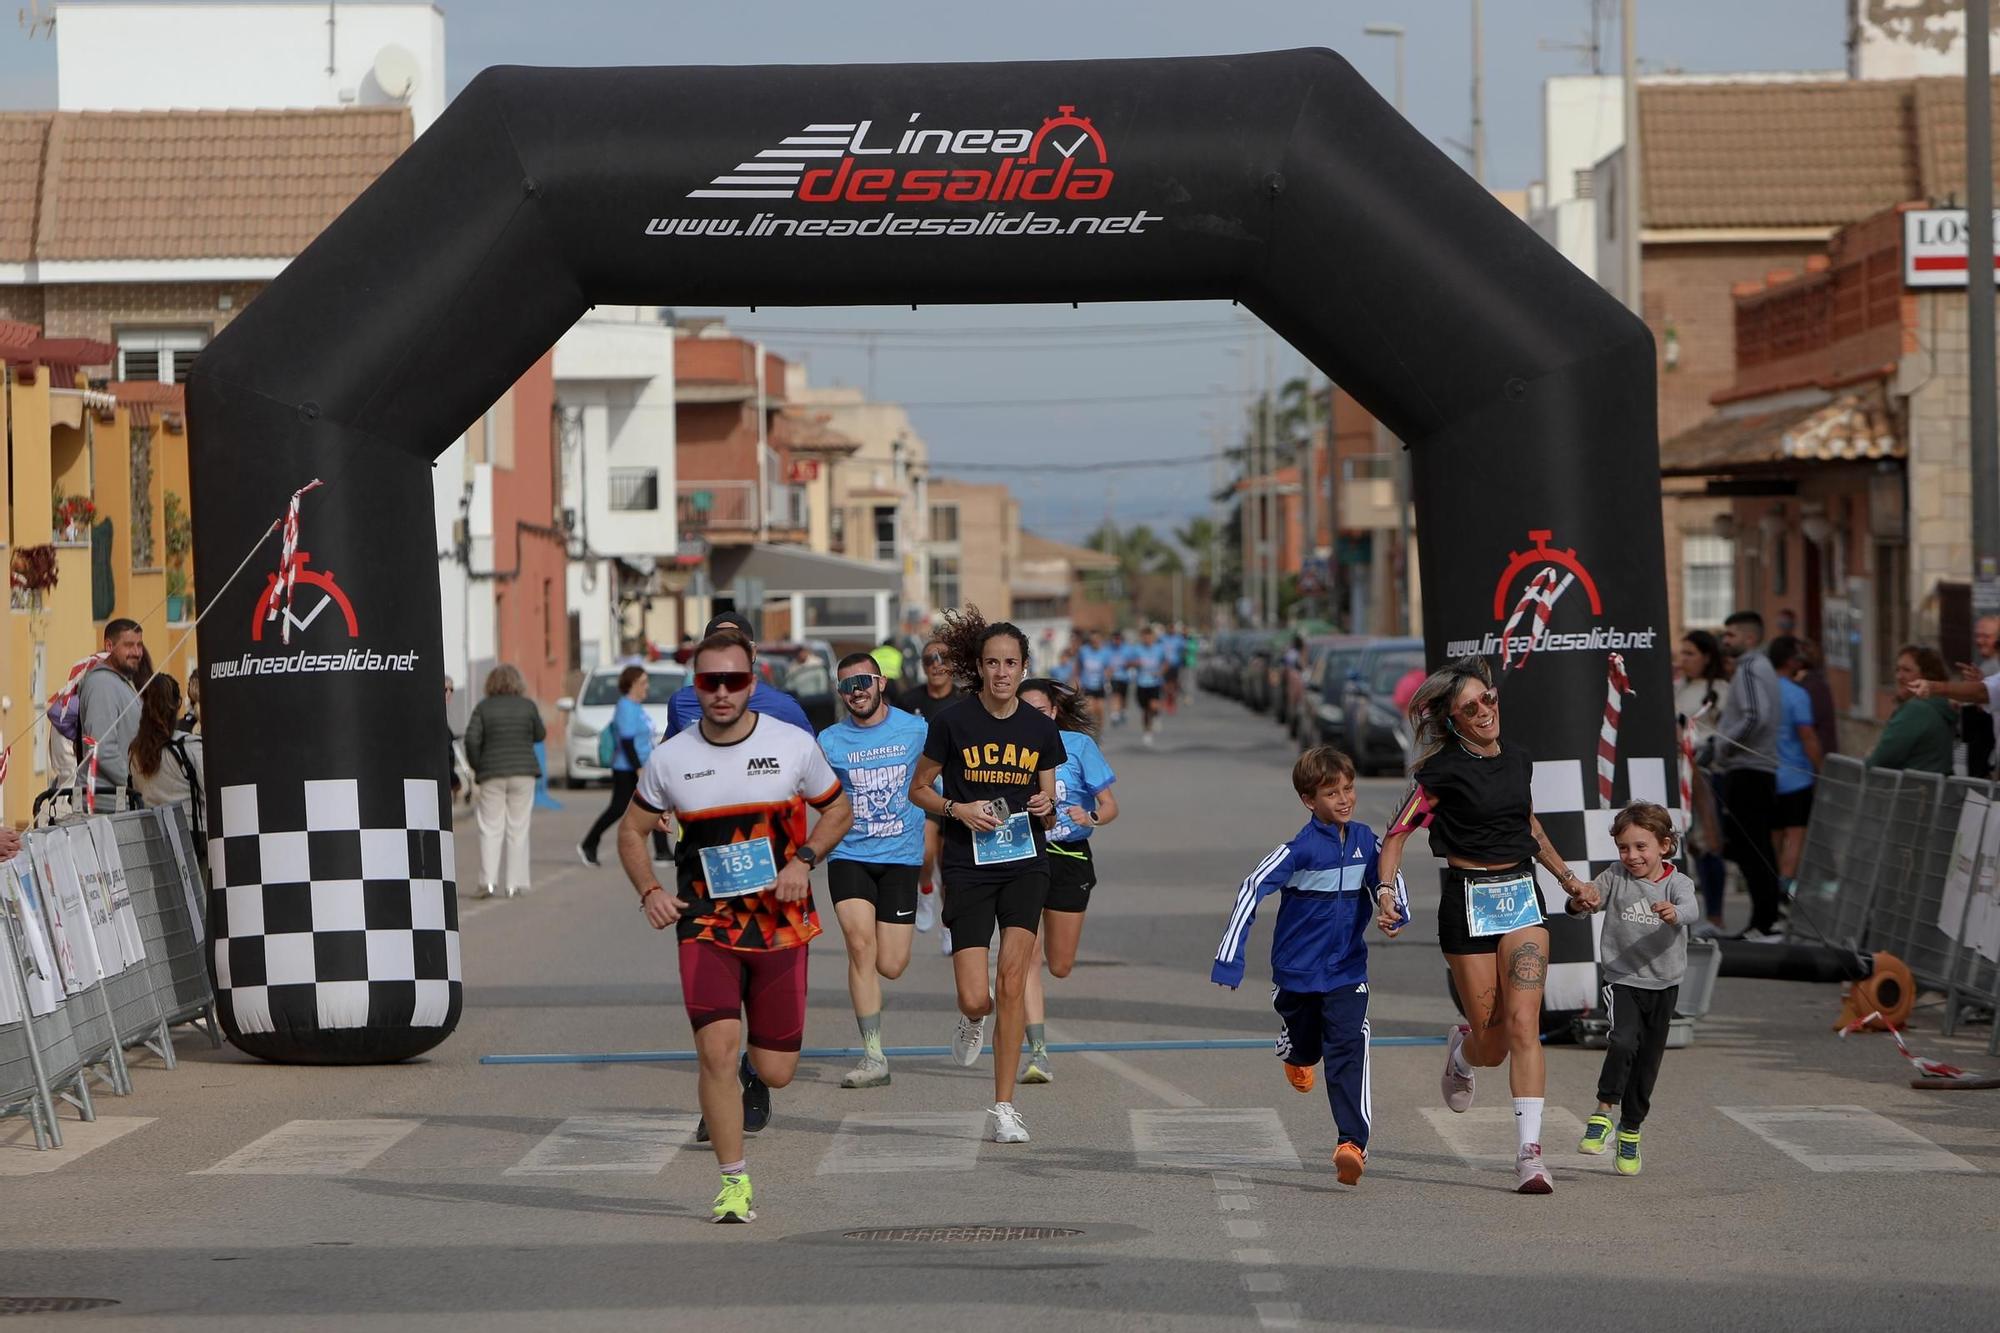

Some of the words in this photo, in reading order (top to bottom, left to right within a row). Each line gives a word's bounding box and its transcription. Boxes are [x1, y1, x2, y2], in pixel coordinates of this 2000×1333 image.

[644, 210, 1164, 238] www.lineadesalida.net
[210, 648, 419, 679] www.lineadesalida.net
[847, 752, 860, 764] VII
[860, 744, 907, 758] CARRERA
[962, 743, 1039, 773] UCAM
[964, 769, 1032, 785] UNIVERSIDA
[995, 829, 1013, 844] 20
[722, 854, 753, 874] 153
[1495, 897, 1515, 913] 40
[1621, 911, 1660, 926] adidas
